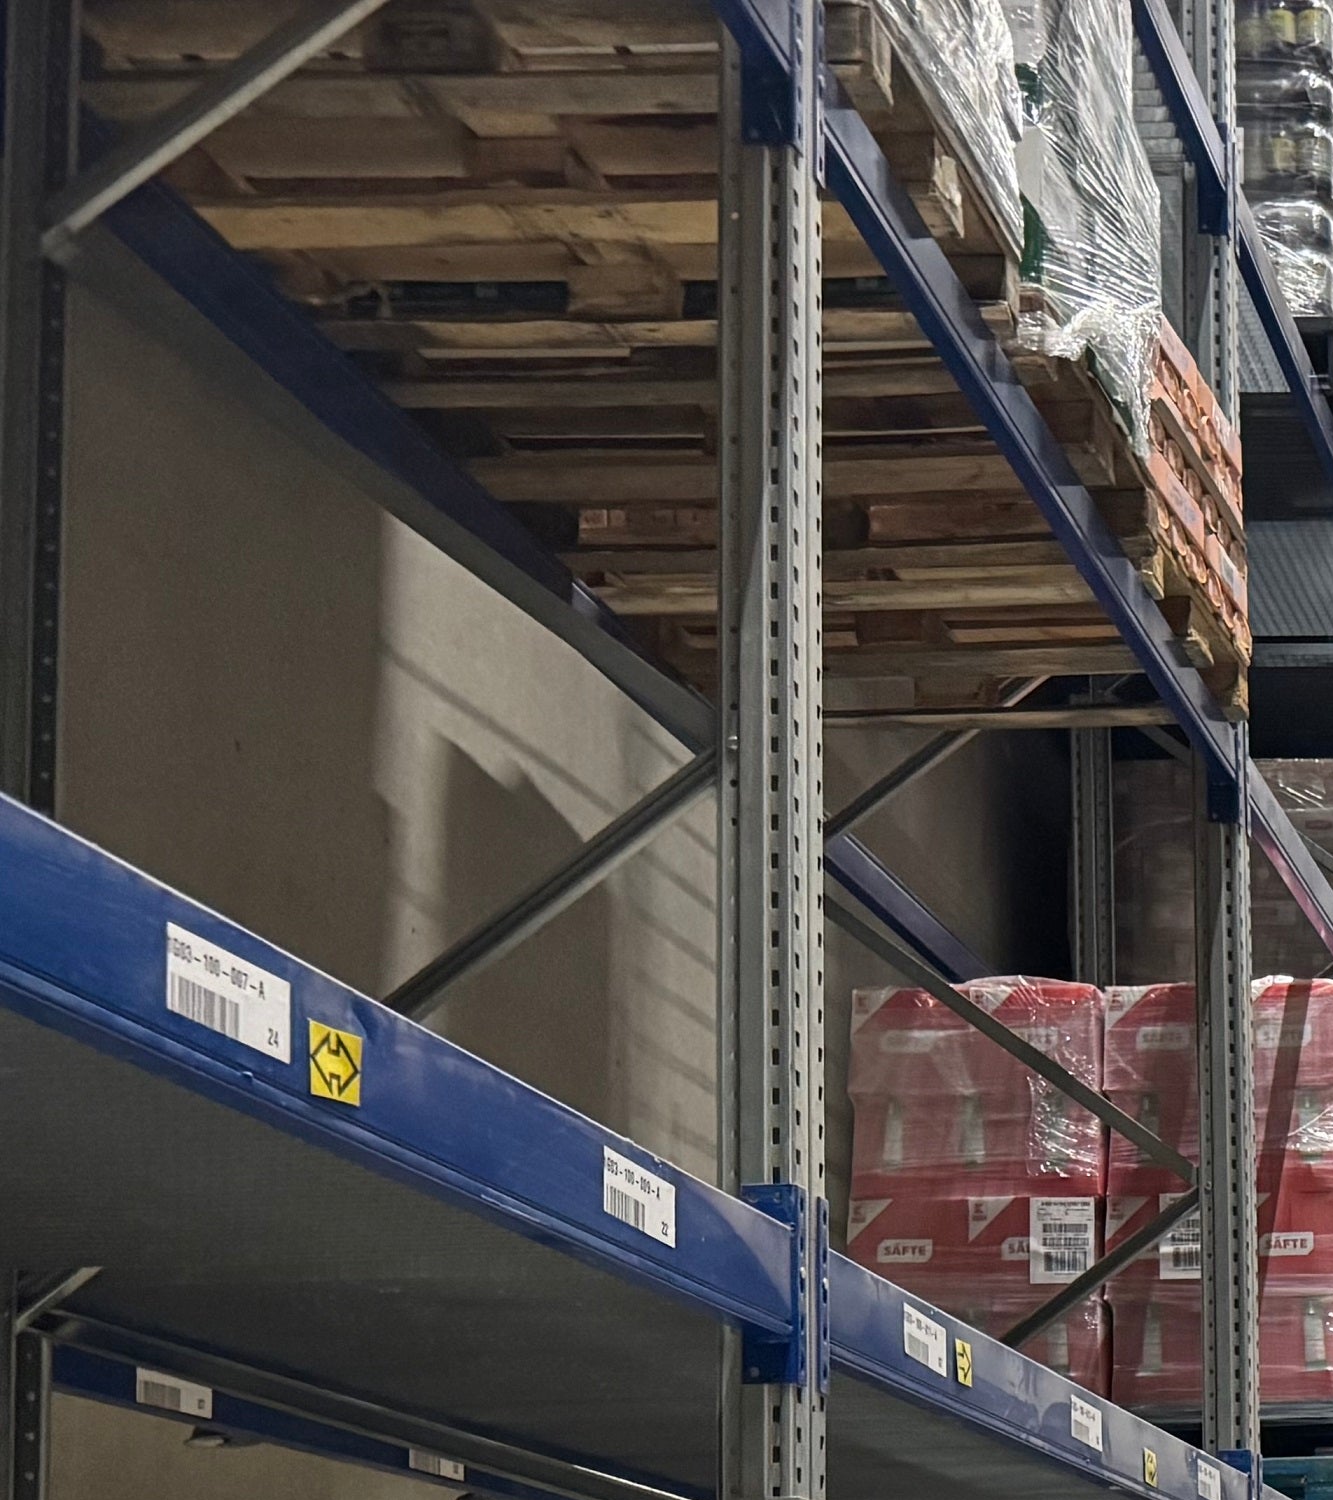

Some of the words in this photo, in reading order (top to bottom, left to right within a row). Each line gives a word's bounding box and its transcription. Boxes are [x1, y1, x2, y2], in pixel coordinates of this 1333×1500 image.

[268, 1028, 279, 1048] 24
[883, 1242, 926, 1256] SÄFTE
[1265, 1236, 1308, 1249] SÄFTE
